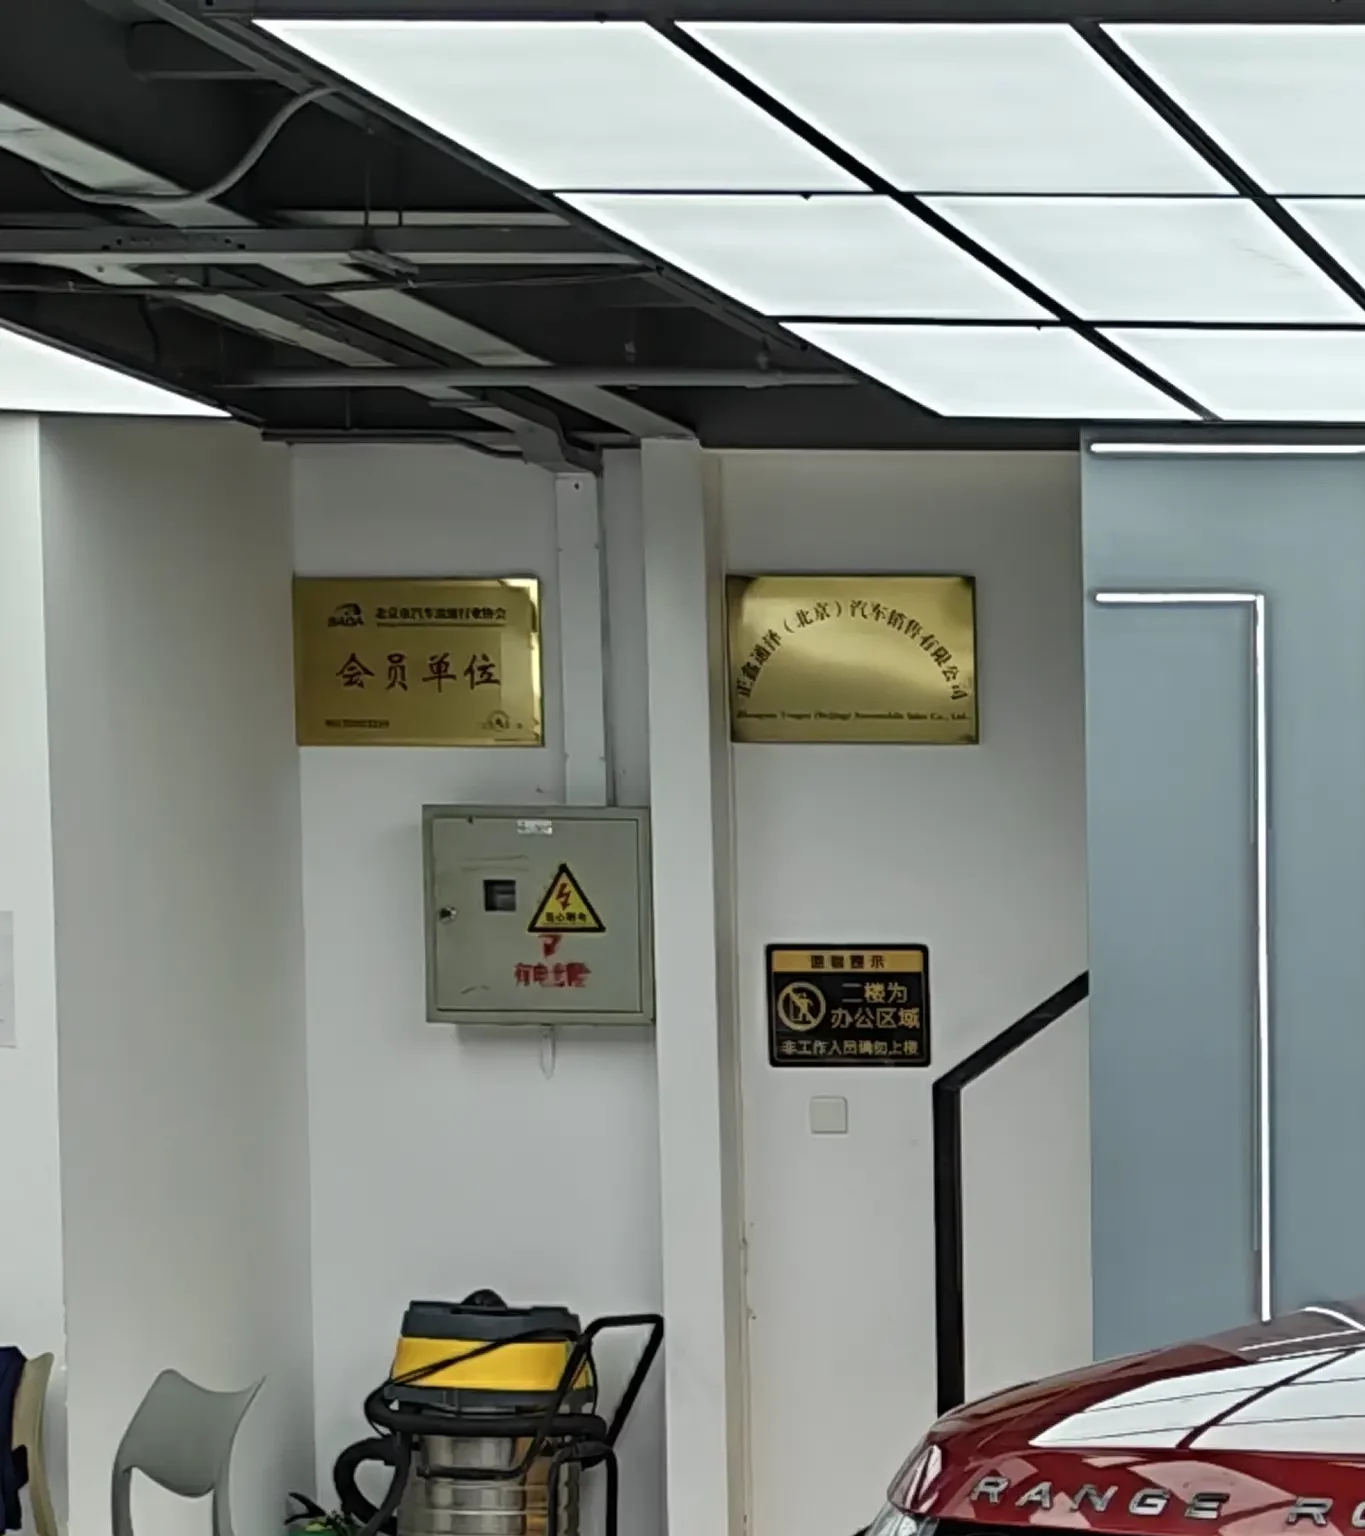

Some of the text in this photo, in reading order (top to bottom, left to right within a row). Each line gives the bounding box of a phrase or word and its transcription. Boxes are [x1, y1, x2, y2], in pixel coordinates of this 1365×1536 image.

[336, 652, 501, 693] 会员单位
[841, 981, 908, 1004] 二楼为
[830, 1007, 920, 1029] 办公区域
[970, 1476, 1231, 1519] RANGE
